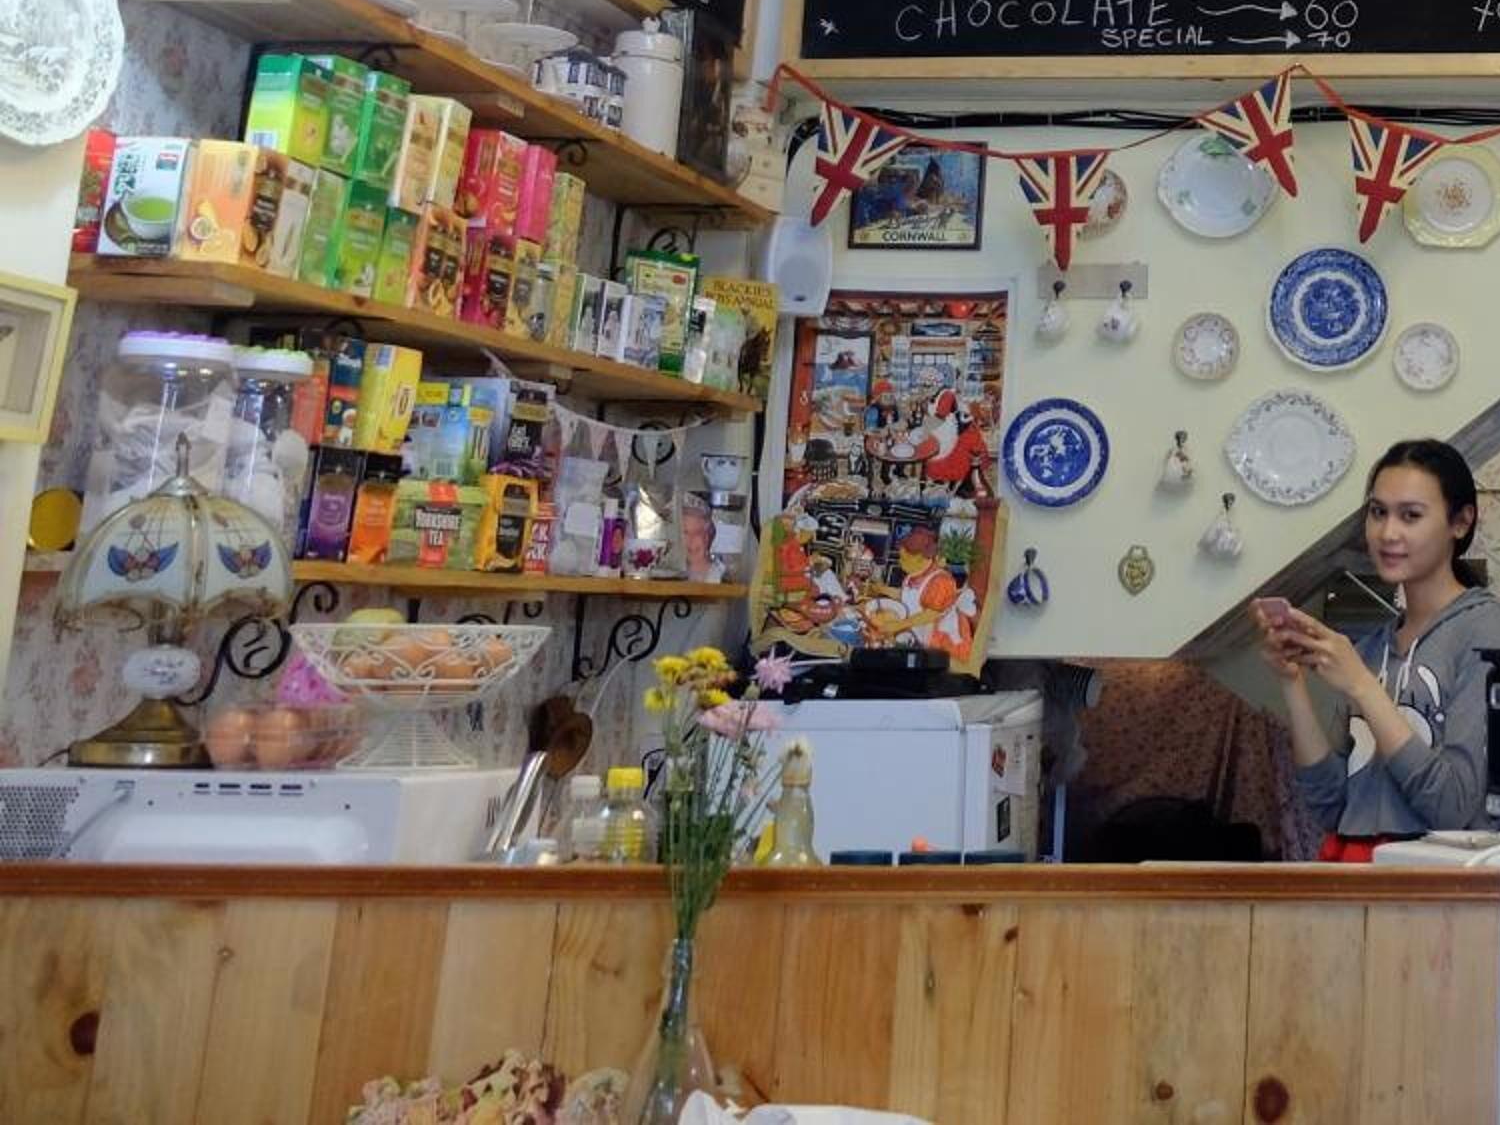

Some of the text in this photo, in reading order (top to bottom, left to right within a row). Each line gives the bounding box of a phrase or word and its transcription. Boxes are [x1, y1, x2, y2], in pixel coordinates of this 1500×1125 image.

[1101, 25, 1351, 49] SPECIAL 70
[882, 230, 946, 242] CORNWALL
